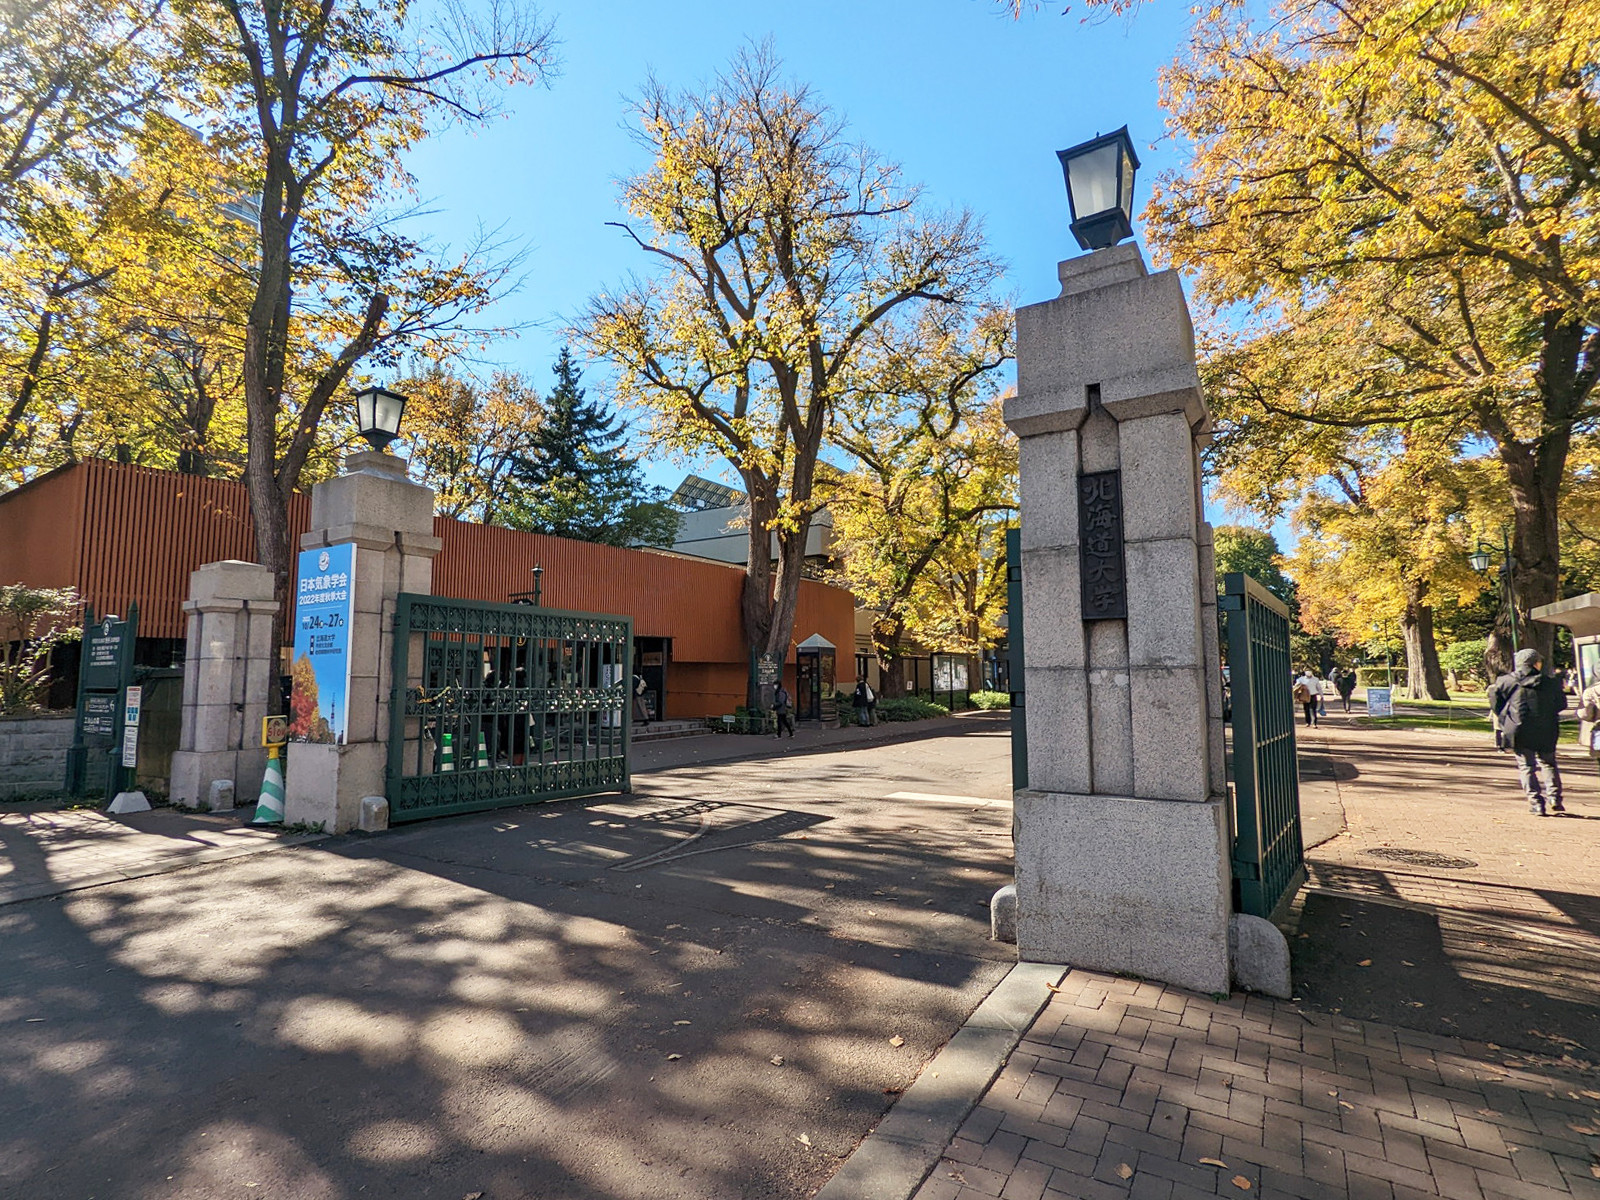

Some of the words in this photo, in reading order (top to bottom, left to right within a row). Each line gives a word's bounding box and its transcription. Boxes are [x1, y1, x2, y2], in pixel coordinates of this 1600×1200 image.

[300, 572, 348, 593] 日本気象学会
[1082, 477, 1120, 612] 北海道大学
